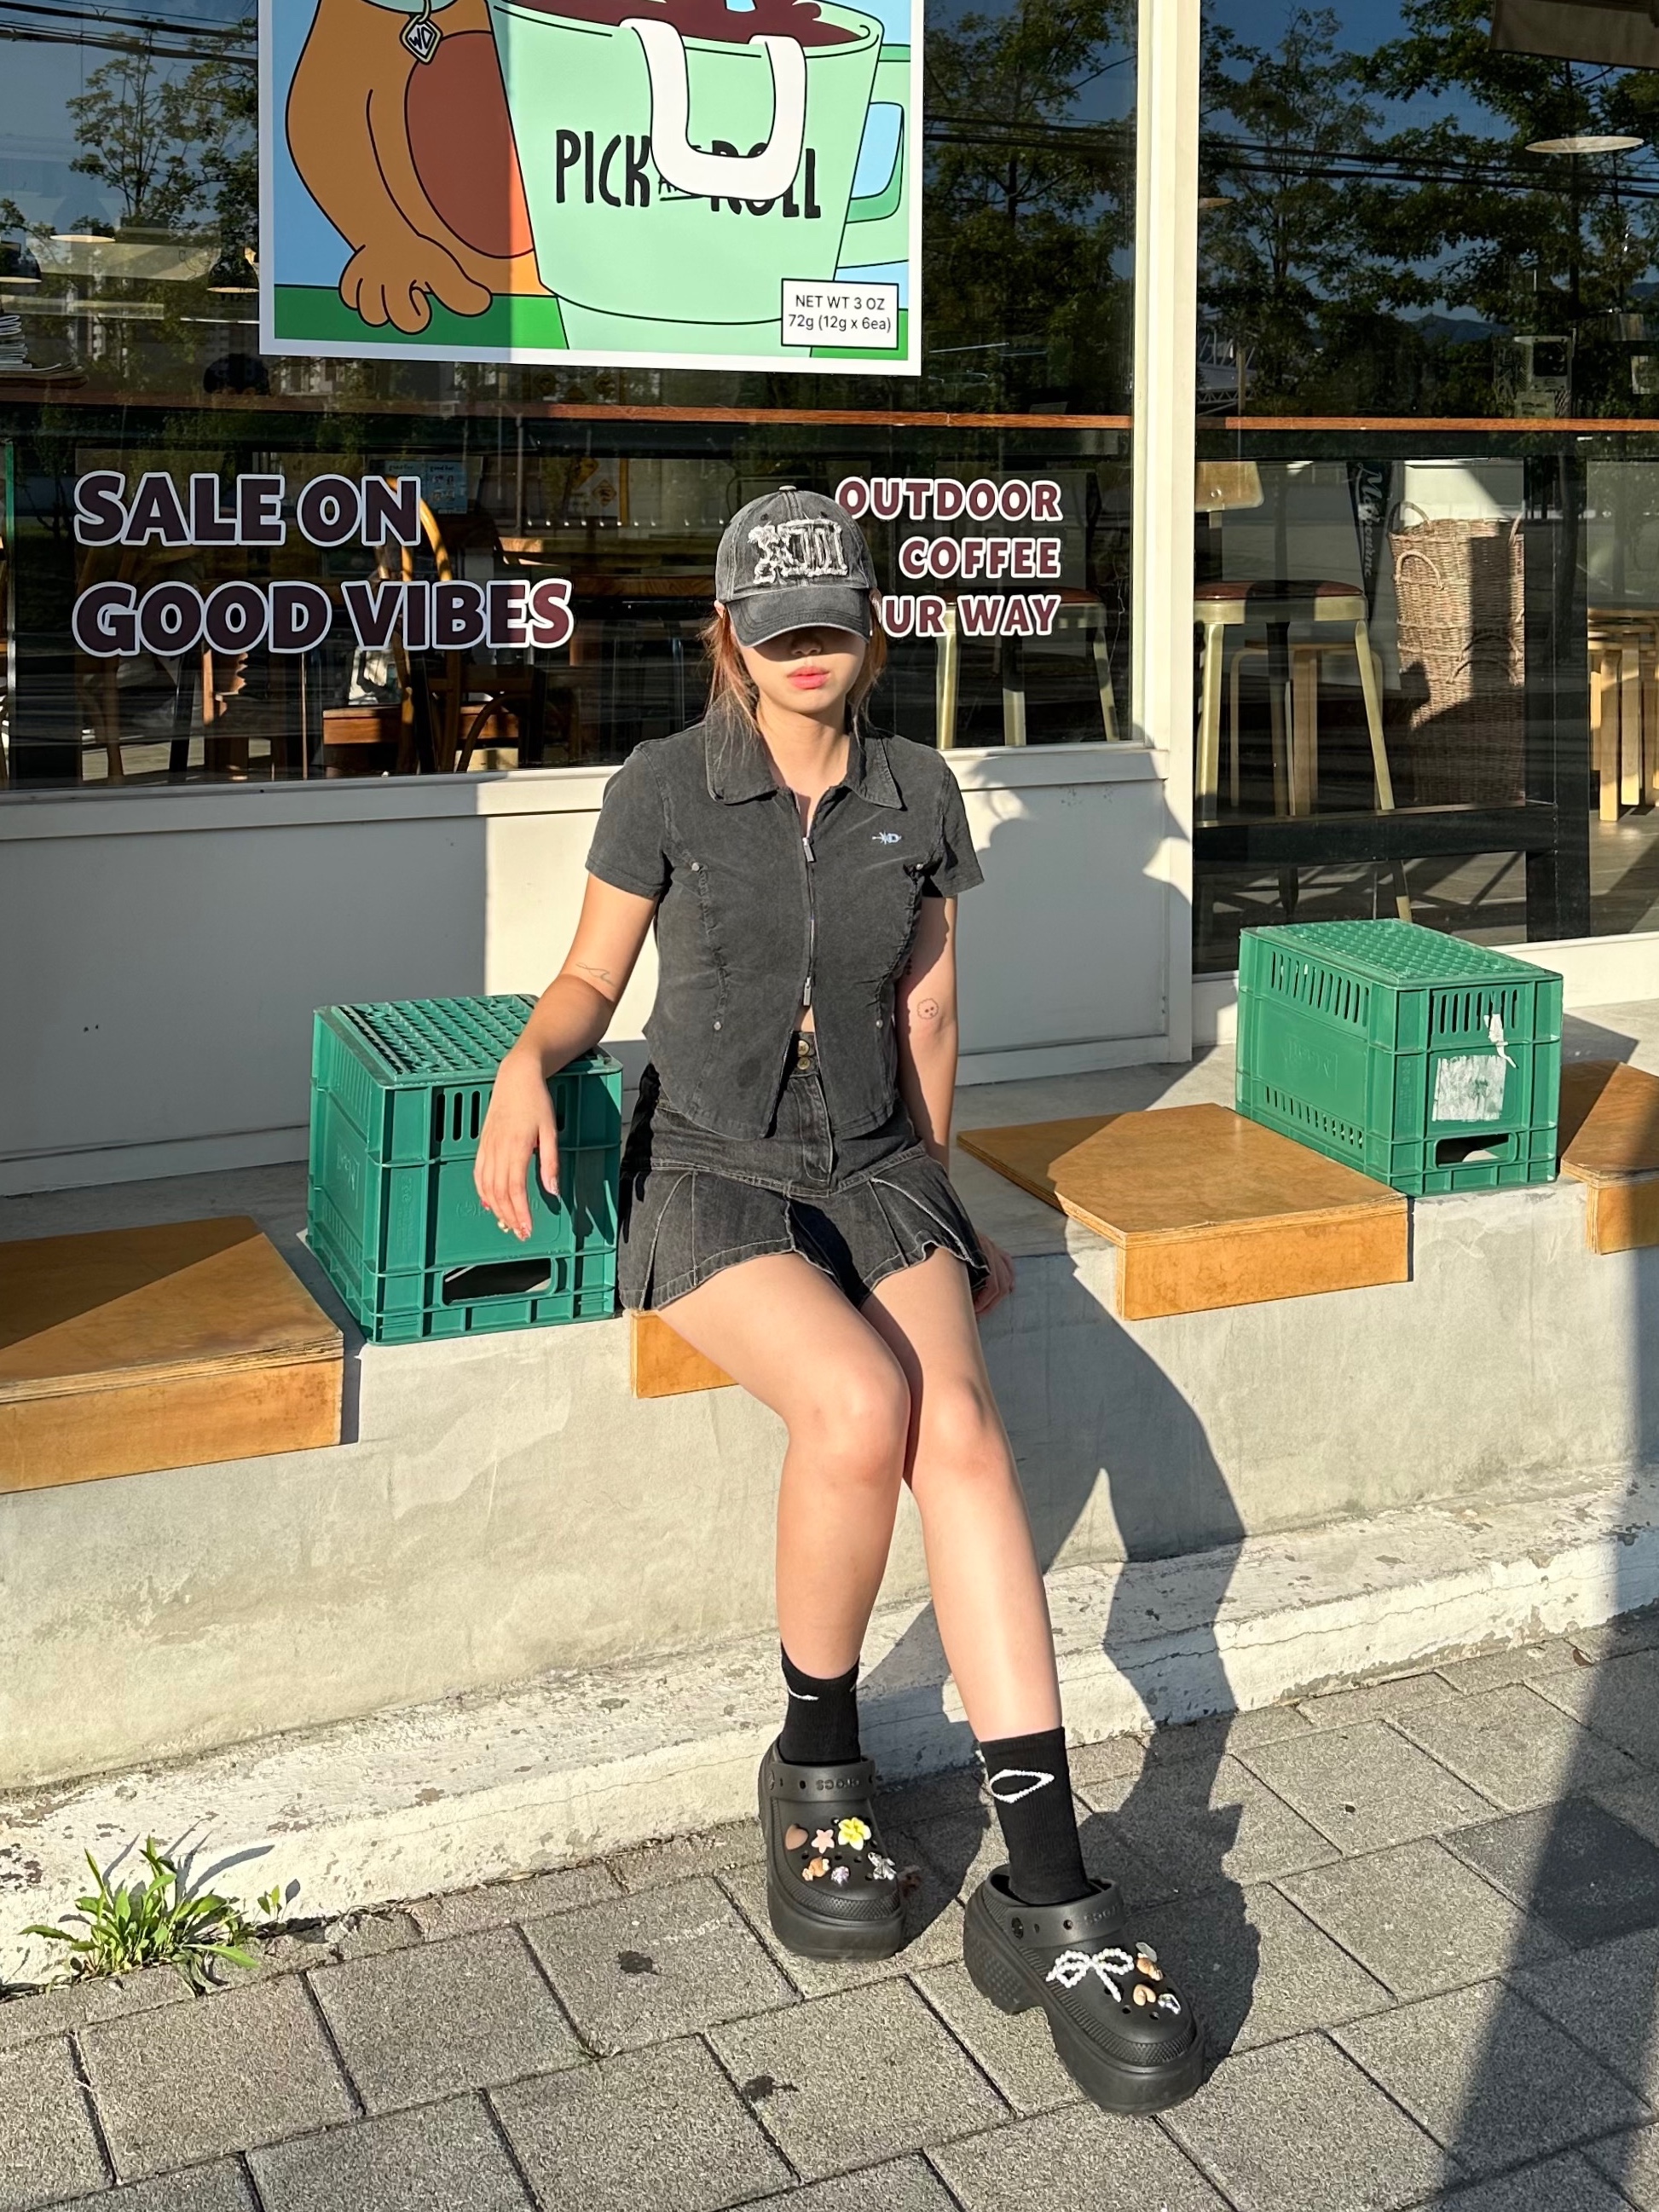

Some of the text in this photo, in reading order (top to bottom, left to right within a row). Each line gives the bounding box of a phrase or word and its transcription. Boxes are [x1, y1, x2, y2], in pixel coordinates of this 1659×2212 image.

[556, 129, 650, 207] PICK
[789, 314, 891, 333] 72g (12g x 6ea)
[795, 294, 885, 310] NET WT 3 OZ
[74, 471, 421, 547] SALE ON
[835, 476, 1063, 522] OUTDOOR
[899, 536, 1061, 580] COFFEE
[72, 577, 575, 656] GOOD VIBES
[870, 594, 1062, 638] UR WAY
